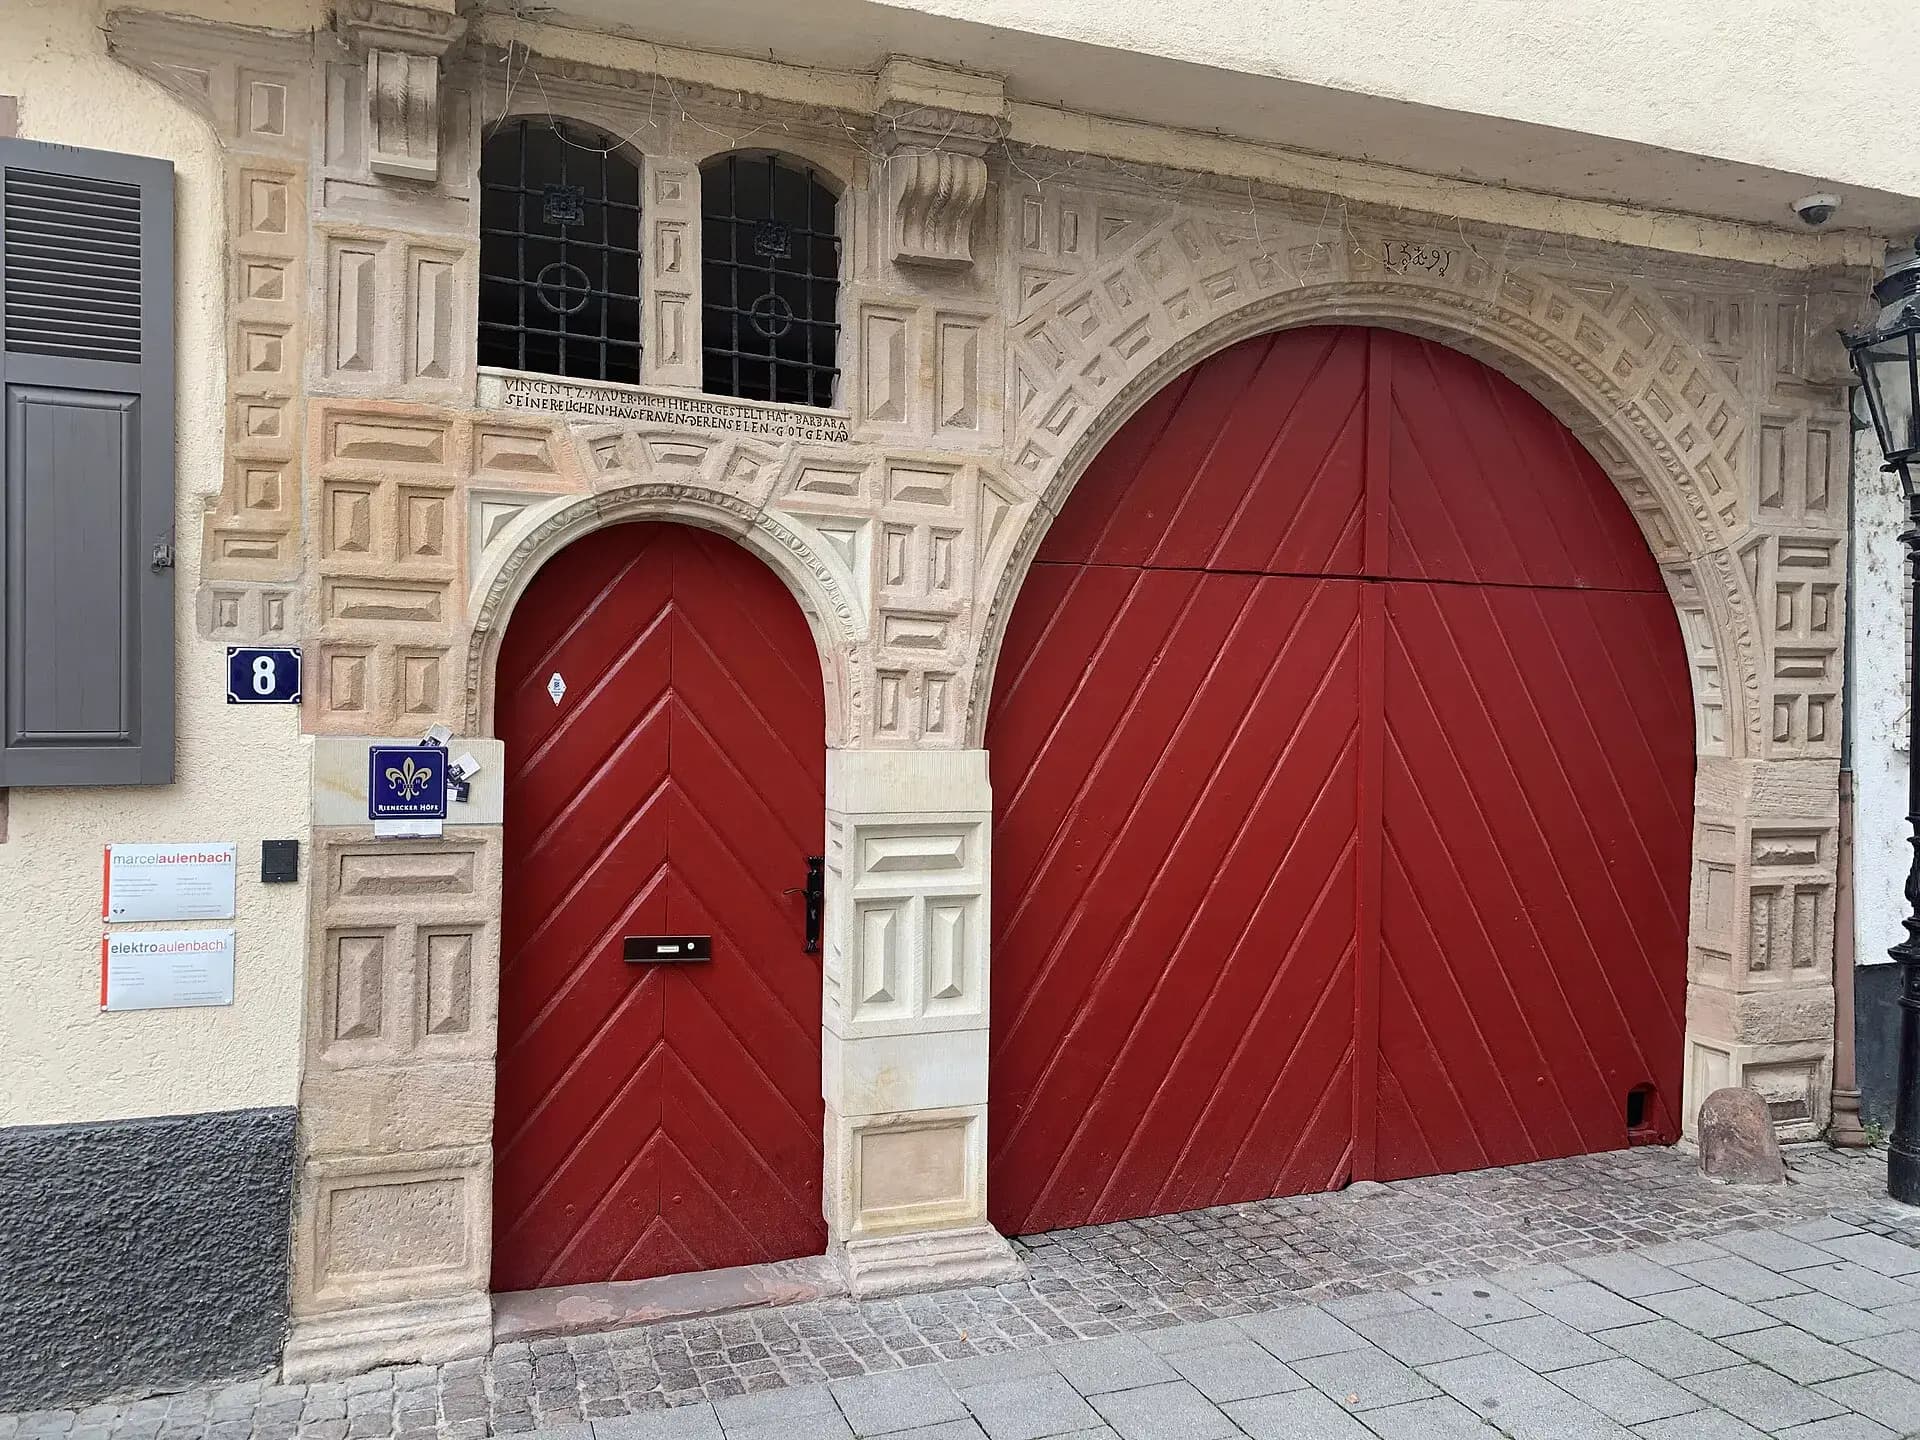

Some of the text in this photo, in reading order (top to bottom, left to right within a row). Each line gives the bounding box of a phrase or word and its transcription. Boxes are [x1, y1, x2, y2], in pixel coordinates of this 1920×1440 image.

[794, 413, 847, 430] BARBARA
[252, 655, 276, 695] 8
[113, 852, 232, 865] marcelaulenbach
